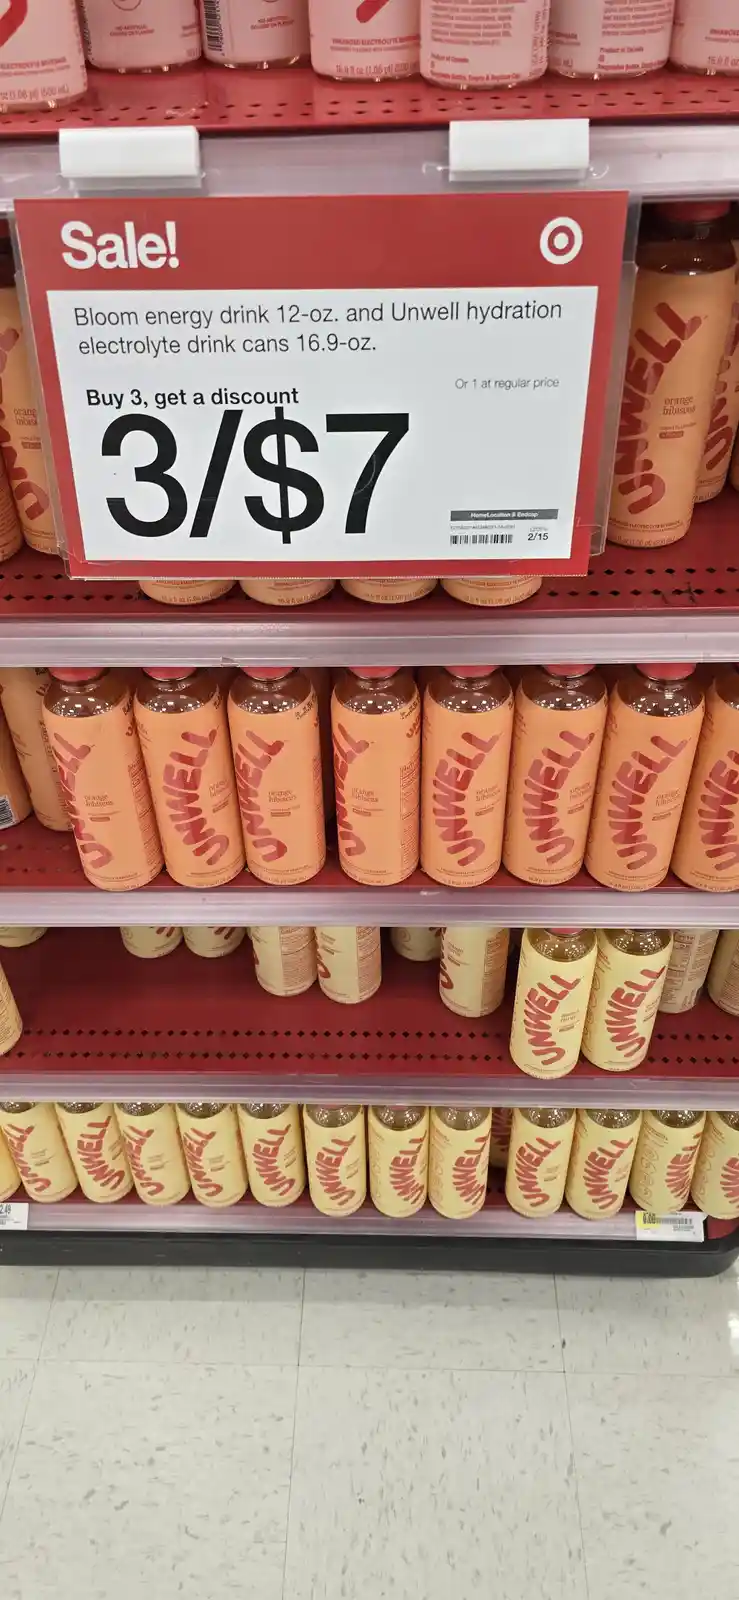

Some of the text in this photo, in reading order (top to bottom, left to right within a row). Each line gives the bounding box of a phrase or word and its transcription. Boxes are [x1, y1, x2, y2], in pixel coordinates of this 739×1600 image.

[60, 220, 180, 270] Sale!
[74, 299, 562, 330] Bloom energy drink 12-oz. and Unwell hydration
[78, 333, 376, 359] electrolyte drink cans 16.9-oz.
[13, 407, 37, 418] orang
[85, 387, 299, 410] Buy 3, get a discount
[454, 378, 560, 391] Or 1 at regular price
[613, 301, 704, 516] UNWELL
[101, 406, 410, 545] 3/$7
[527, 532, 549, 541] 2/15
[162, 728, 229, 866] UNWELL
[234, 729, 288, 863] UNWELL
[432, 731, 501, 867] UNWELL
[522, 730, 595, 864] UNWELL
[607, 735, 688, 871] UNWELL
[524, 974, 581, 1066] UNWELL
[605, 965, 666, 1058] UNWELL
[77, 1115, 126, 1191] UNWELL
[183, 1127, 225, 1197] UNWELL
[252, 1123, 296, 1197] UNWELL
[315, 1135, 356, 1206] UNWELL
[389, 1130, 428, 1205] UNWELL
[452, 1130, 491, 1206] UNWELL
[515, 1136, 562, 1208] UNWELL
[582, 1138, 634, 1210] UNWELL
